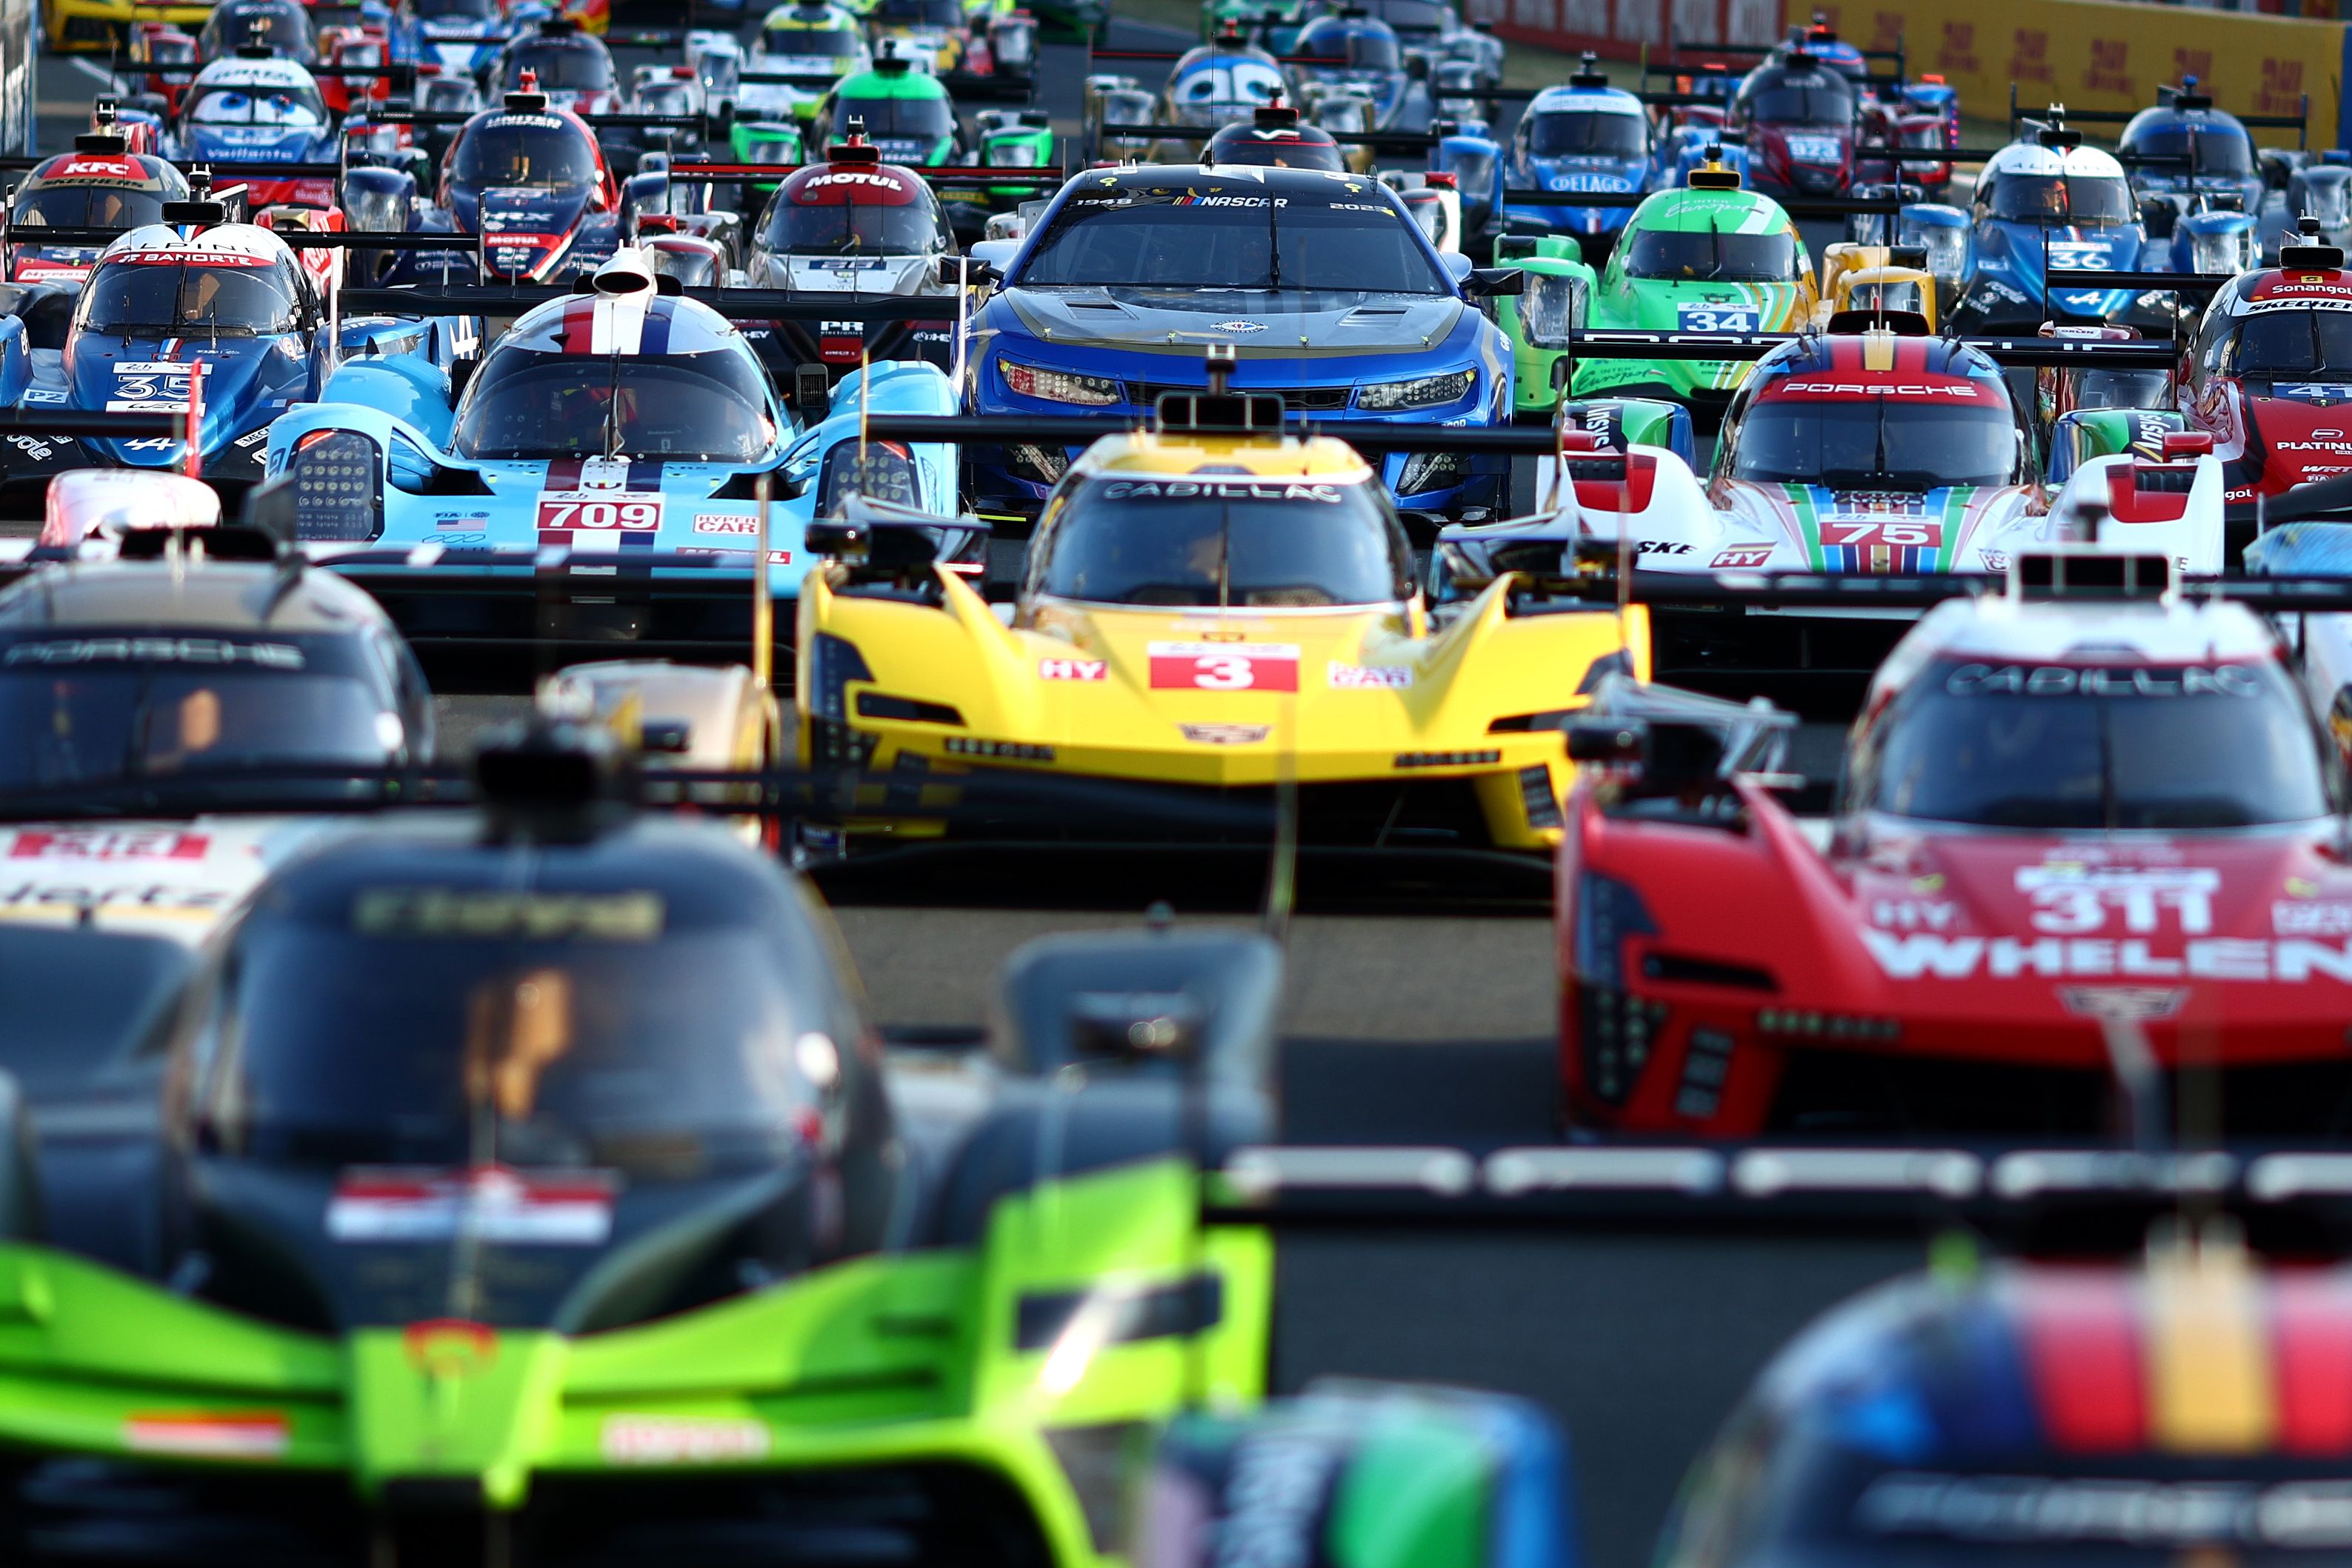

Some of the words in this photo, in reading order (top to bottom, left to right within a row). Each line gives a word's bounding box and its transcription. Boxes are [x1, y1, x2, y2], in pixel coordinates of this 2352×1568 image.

[63, 161, 130, 176] KFC
[805, 173, 902, 191] MOTUL
[1558, 176, 1622, 192] DELAGE
[1200, 196, 1288, 208] NASCAR
[487, 236, 540, 244] MOTUL
[143, 253, 253, 266] BANORTE
[2050, 250, 2110, 269] 36
[2246, 299, 2352, 313] SKECHER
[1686, 311, 1753, 333] 34
[28, 390, 64, 402] P2
[114, 375, 201, 400] 35
[1782, 381, 1978, 398] PORSCHE
[2276, 441, 2352, 450] PLATINU
[1105, 481, 1343, 504] CADILLAC
[542, 503, 658, 528] 709
[699, 516, 756, 524] HYPER
[699, 521, 756, 533] CAR
[1831, 523, 1930, 544] 75
[1636, 541, 1697, 554] SKE
[1713, 553, 1763, 565] HY
[1040, 660, 1105, 679] HY
[1194, 653, 1255, 689] 3
[1946, 663, 2262, 697] CADILLAC
[2031, 887, 2213, 934] 311
[1858, 935, 2352, 983] WHELEN
